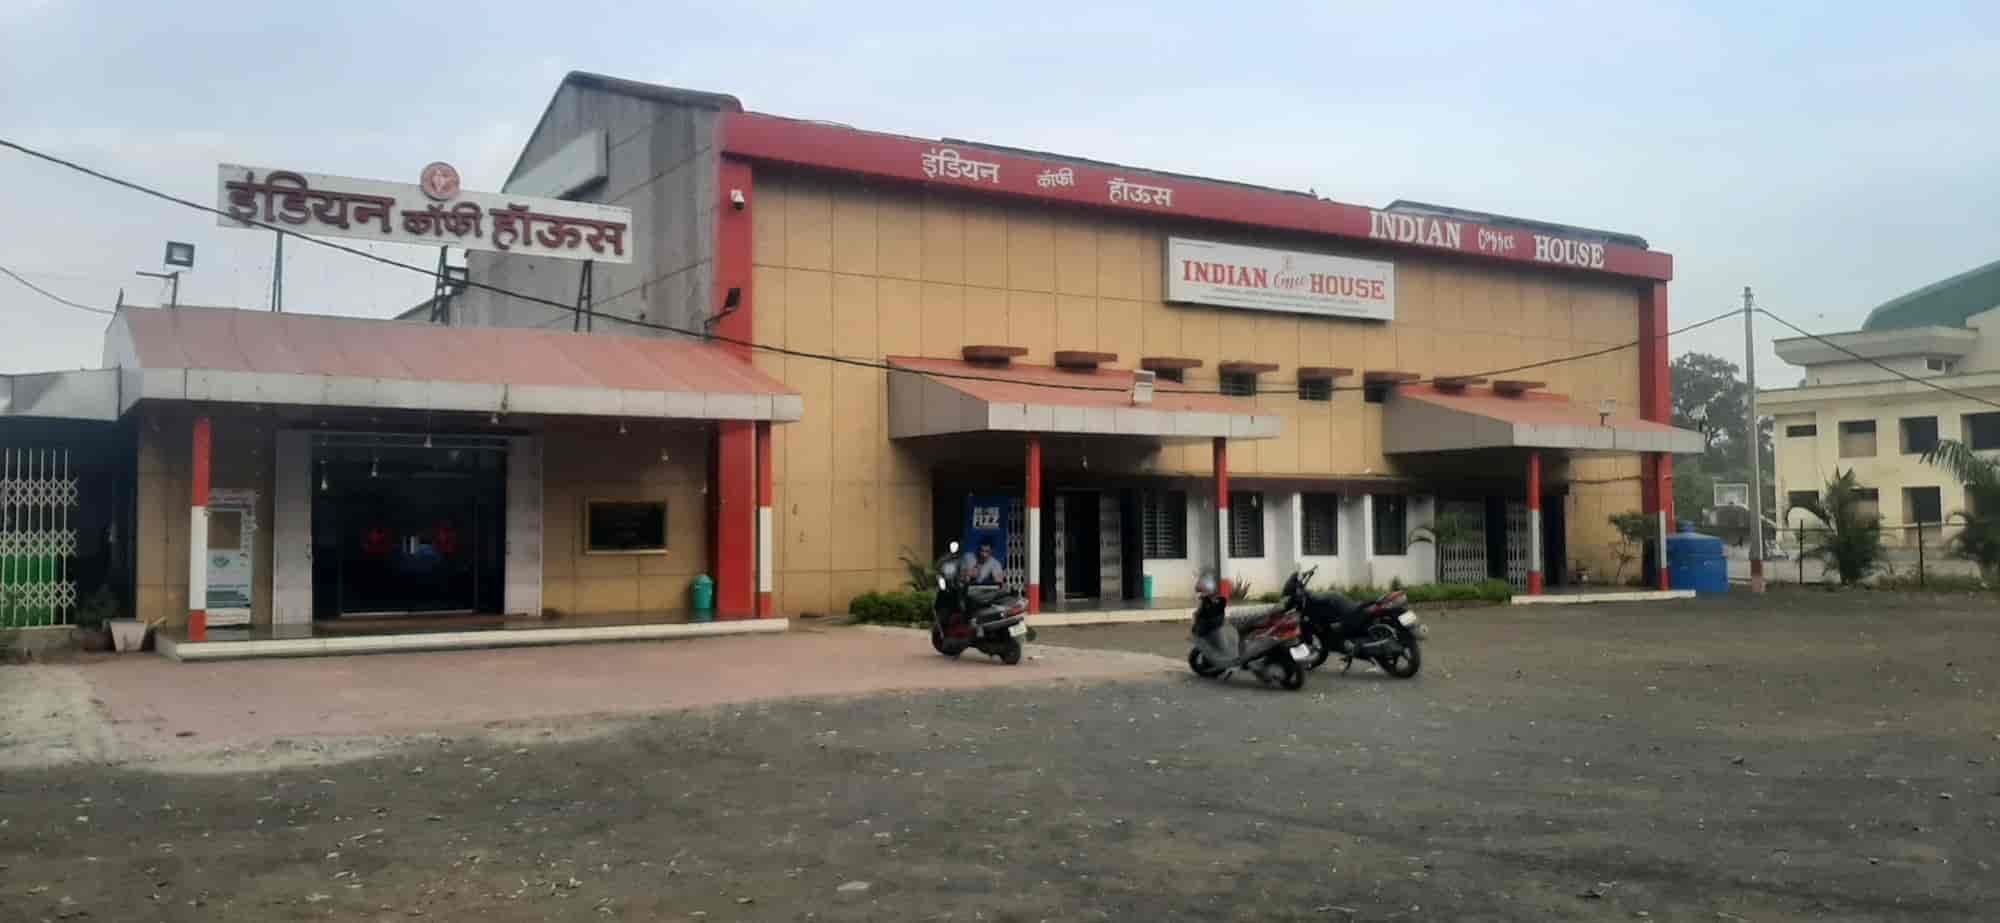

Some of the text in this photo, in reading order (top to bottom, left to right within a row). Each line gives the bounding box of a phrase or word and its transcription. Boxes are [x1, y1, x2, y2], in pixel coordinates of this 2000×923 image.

[920, 148, 1000, 184] इंडियन
[1108, 177, 1173, 207] हॉऊस
[226, 170, 627, 255] इंडियन कॉफी हॉऊस
[1369, 210, 1463, 249] INDIAN
[1533, 235, 1605, 269] HOUSE
[1182, 260, 1269, 289] INDIAN
[1310, 273, 1385, 300] HOUSE
[972, 512, 1000, 528] FIZZ
